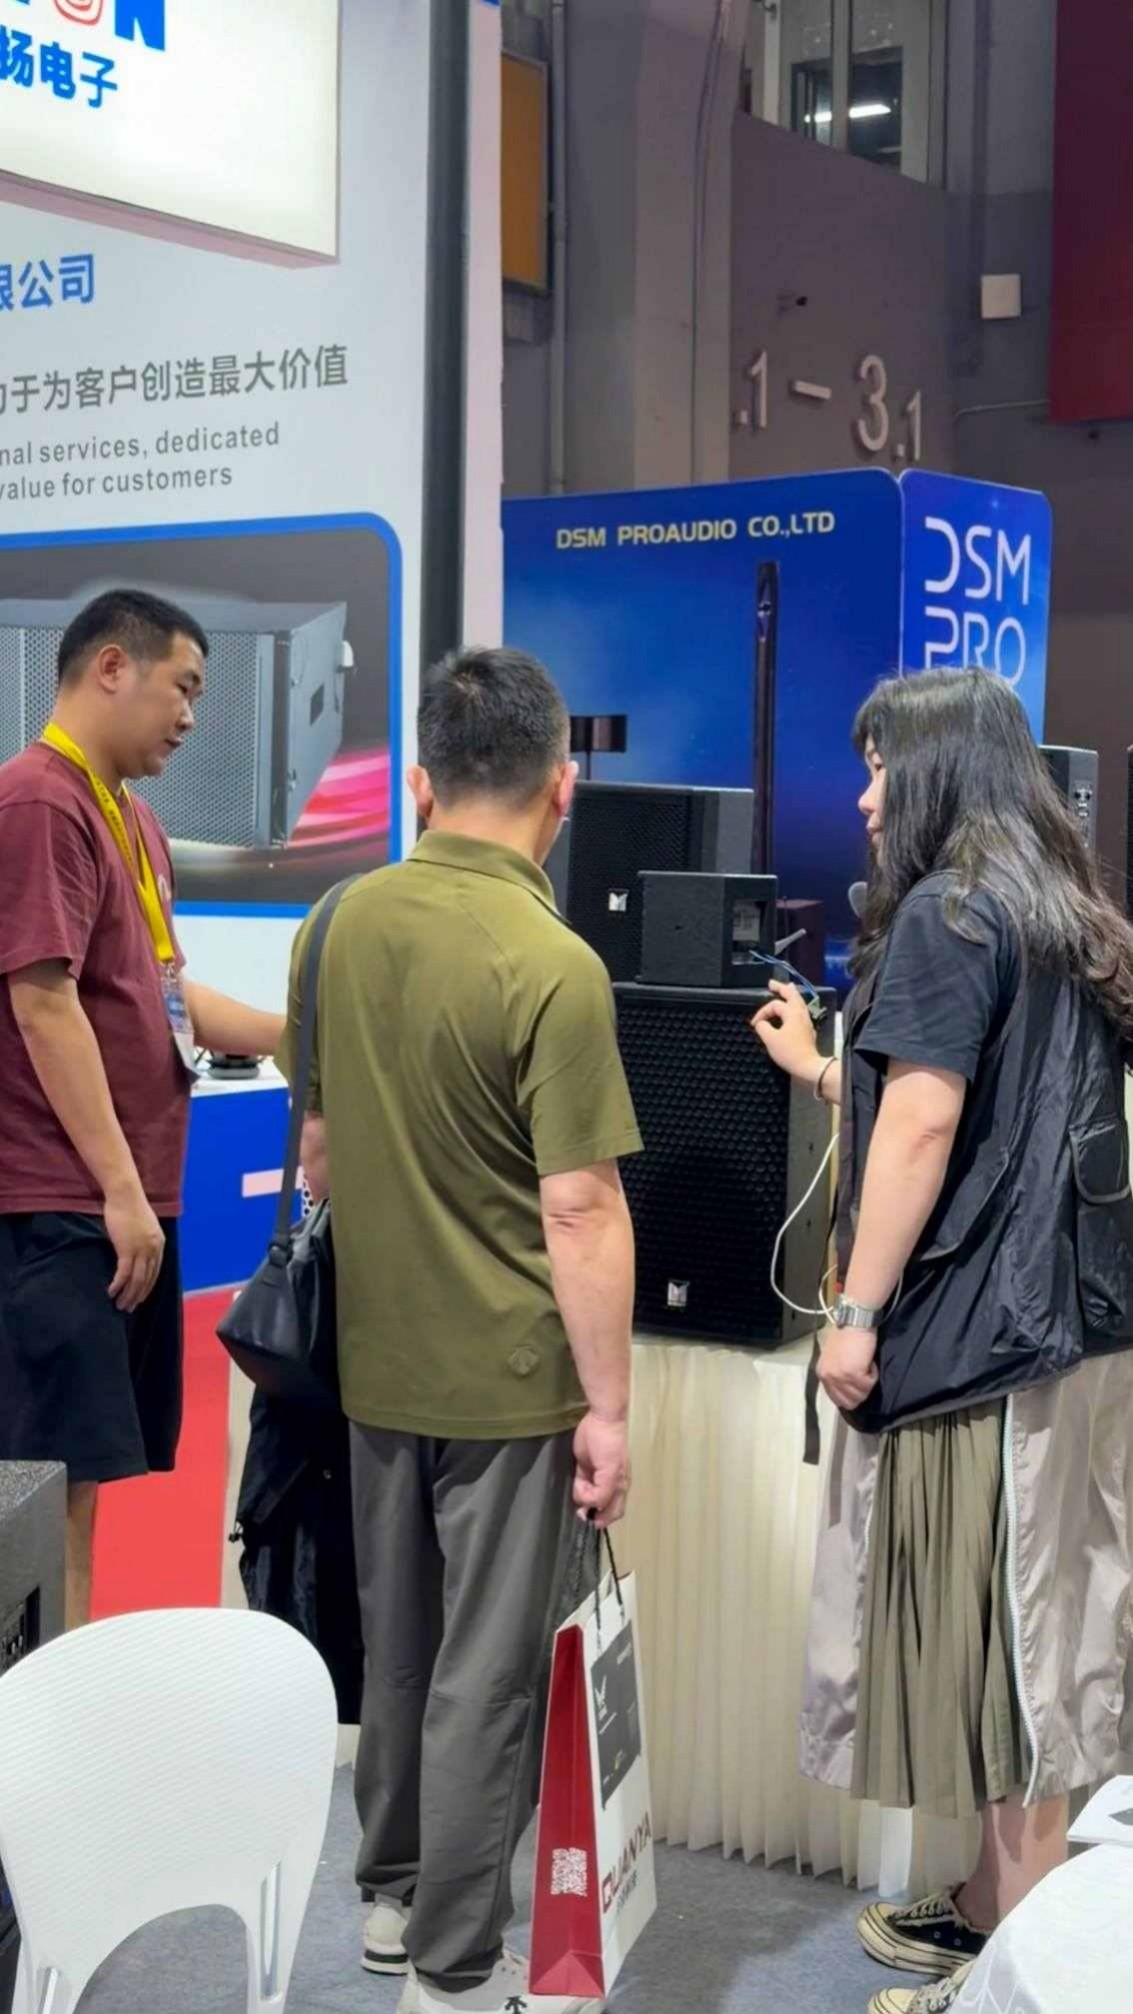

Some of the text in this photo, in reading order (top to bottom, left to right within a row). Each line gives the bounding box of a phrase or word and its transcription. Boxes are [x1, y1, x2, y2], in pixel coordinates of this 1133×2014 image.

[0, 344, 348, 416] 于为客户创造最大价值
[40, 436, 149, 463] services,
[156, 421, 280, 455] dedicated
[62, 472, 95, 496] for
[103, 467, 233, 493] customers
[556, 527, 607, 550] DSM
[617, 519, 737, 546] PROAUDIO
[925, 516, 1031, 605] DSM
[925, 606, 1026, 686] PRO
